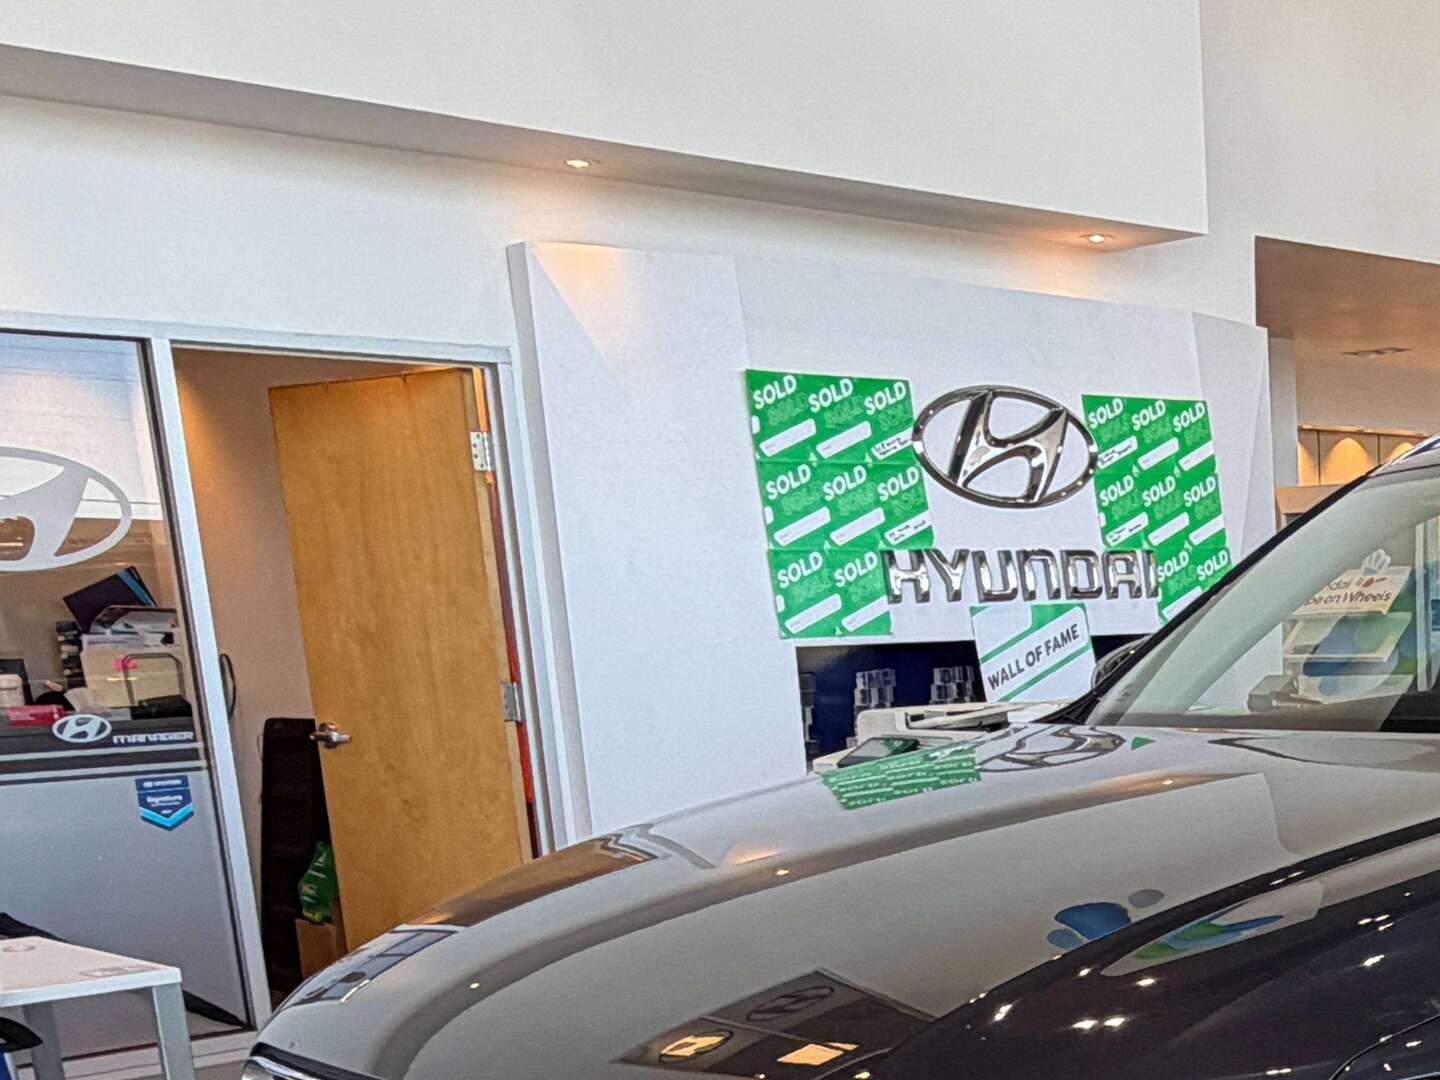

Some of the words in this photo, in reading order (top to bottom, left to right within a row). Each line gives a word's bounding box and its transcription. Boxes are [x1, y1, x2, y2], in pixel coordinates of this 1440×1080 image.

[753, 375, 797, 409] SOLD
[808, 379, 853, 412] SOLD
[864, 382, 906, 415] SOLD
[1088, 398, 1124, 429] SOLD
[1132, 400, 1166, 431] SOLD
[1173, 402, 1206, 432] SOLD
[766, 464, 811, 499] SOLD
[823, 465, 867, 501] SOLD
[878, 466, 920, 501] SOLD
[1100, 475, 1134, 506] SOLD
[1142, 476, 1176, 507] SOLD
[1183, 476, 1216, 507] SOLD
[777, 552, 823, 588] SOLD
[834, 552, 878, 587] SOLD
[884, 549, 1160, 603] HYUNDAI
[1157, 551, 1189, 582] SOLD
[1196, 550, 1228, 581] SOLD
[1343, 591, 1393, 603] Wheels
[987, 660, 1025, 691] WALL
[1026, 645, 1043, 668] OF
[1044, 623, 1080, 657] FAME
